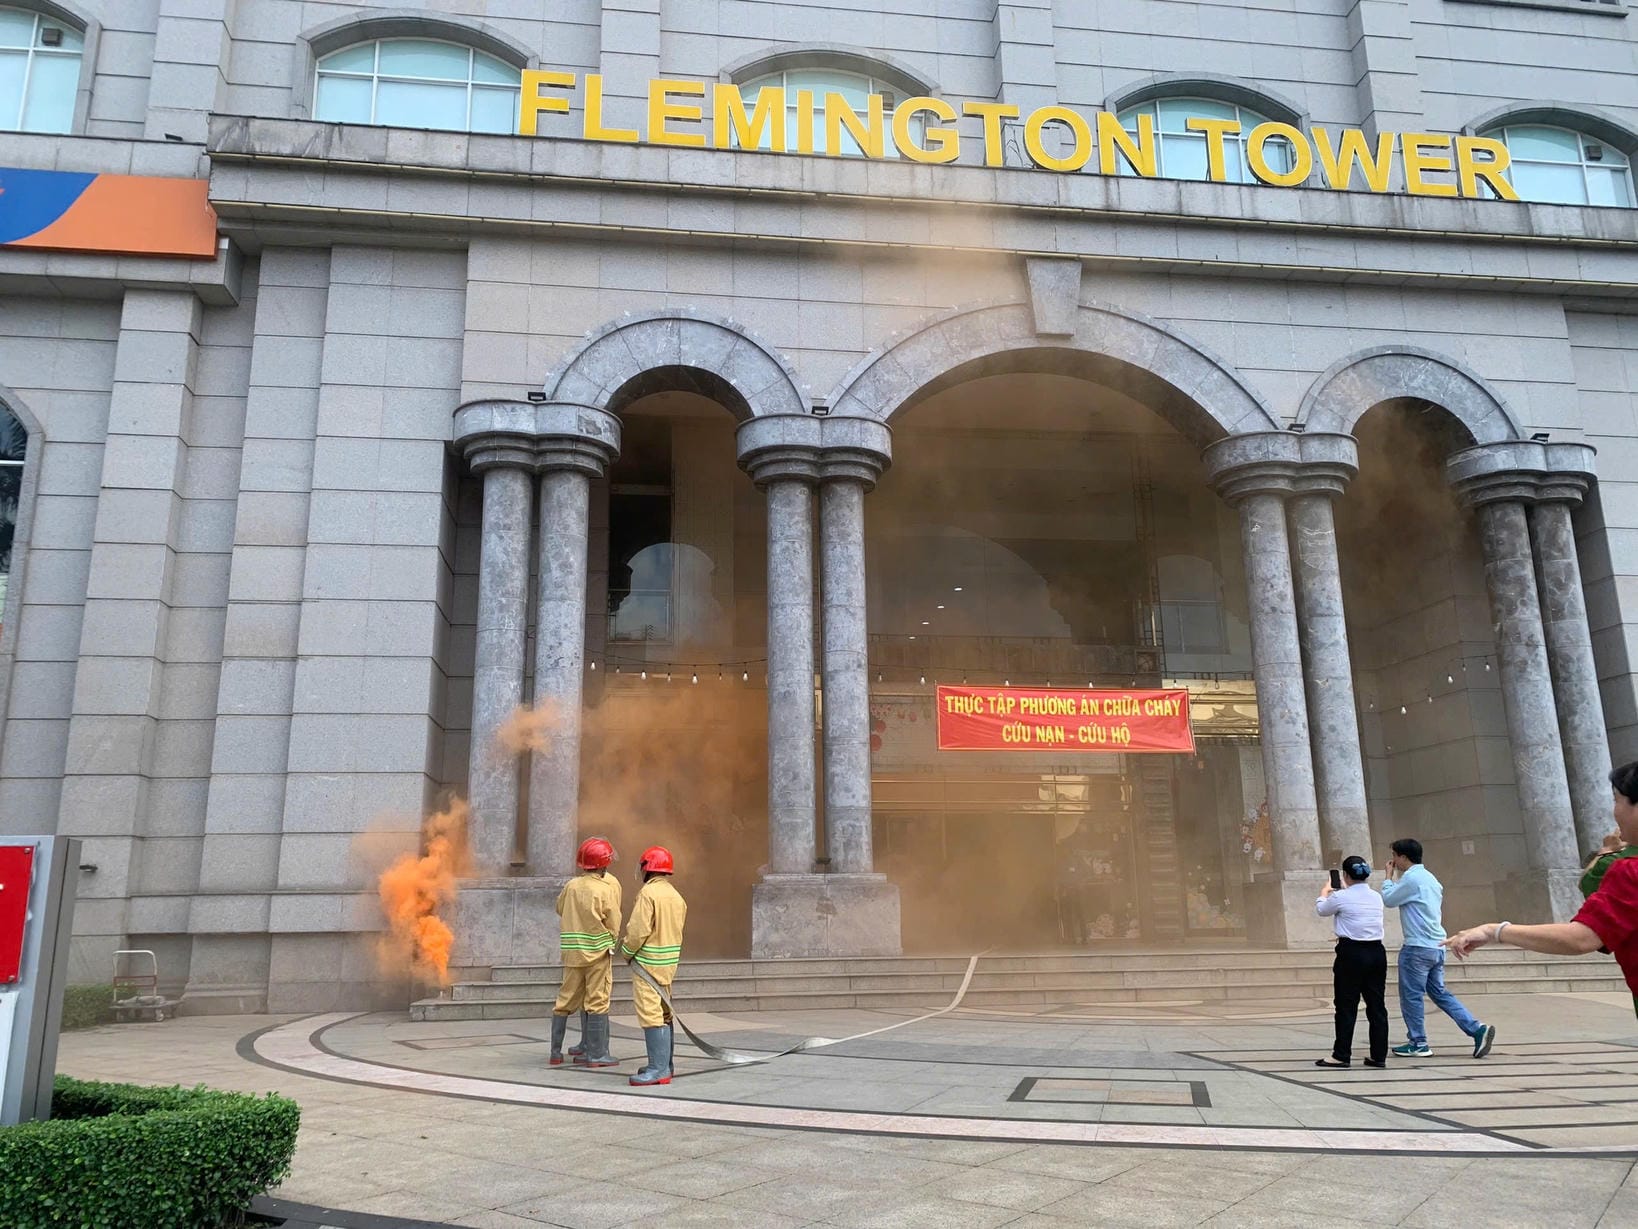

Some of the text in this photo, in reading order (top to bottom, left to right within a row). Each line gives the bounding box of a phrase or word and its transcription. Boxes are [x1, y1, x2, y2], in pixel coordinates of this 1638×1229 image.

[518, 68, 1521, 201] FLEMINGTON TOWER
[945, 692, 1182, 718] THỰC TẬP PHƯƠNG ÁN CHỮA CHÁY
[1002, 722, 1031, 743] CỨU
[1036, 725, 1065, 747] NẠN
[1078, 722, 1107, 743] CỨU
[1111, 722, 1130, 747] HỘ
